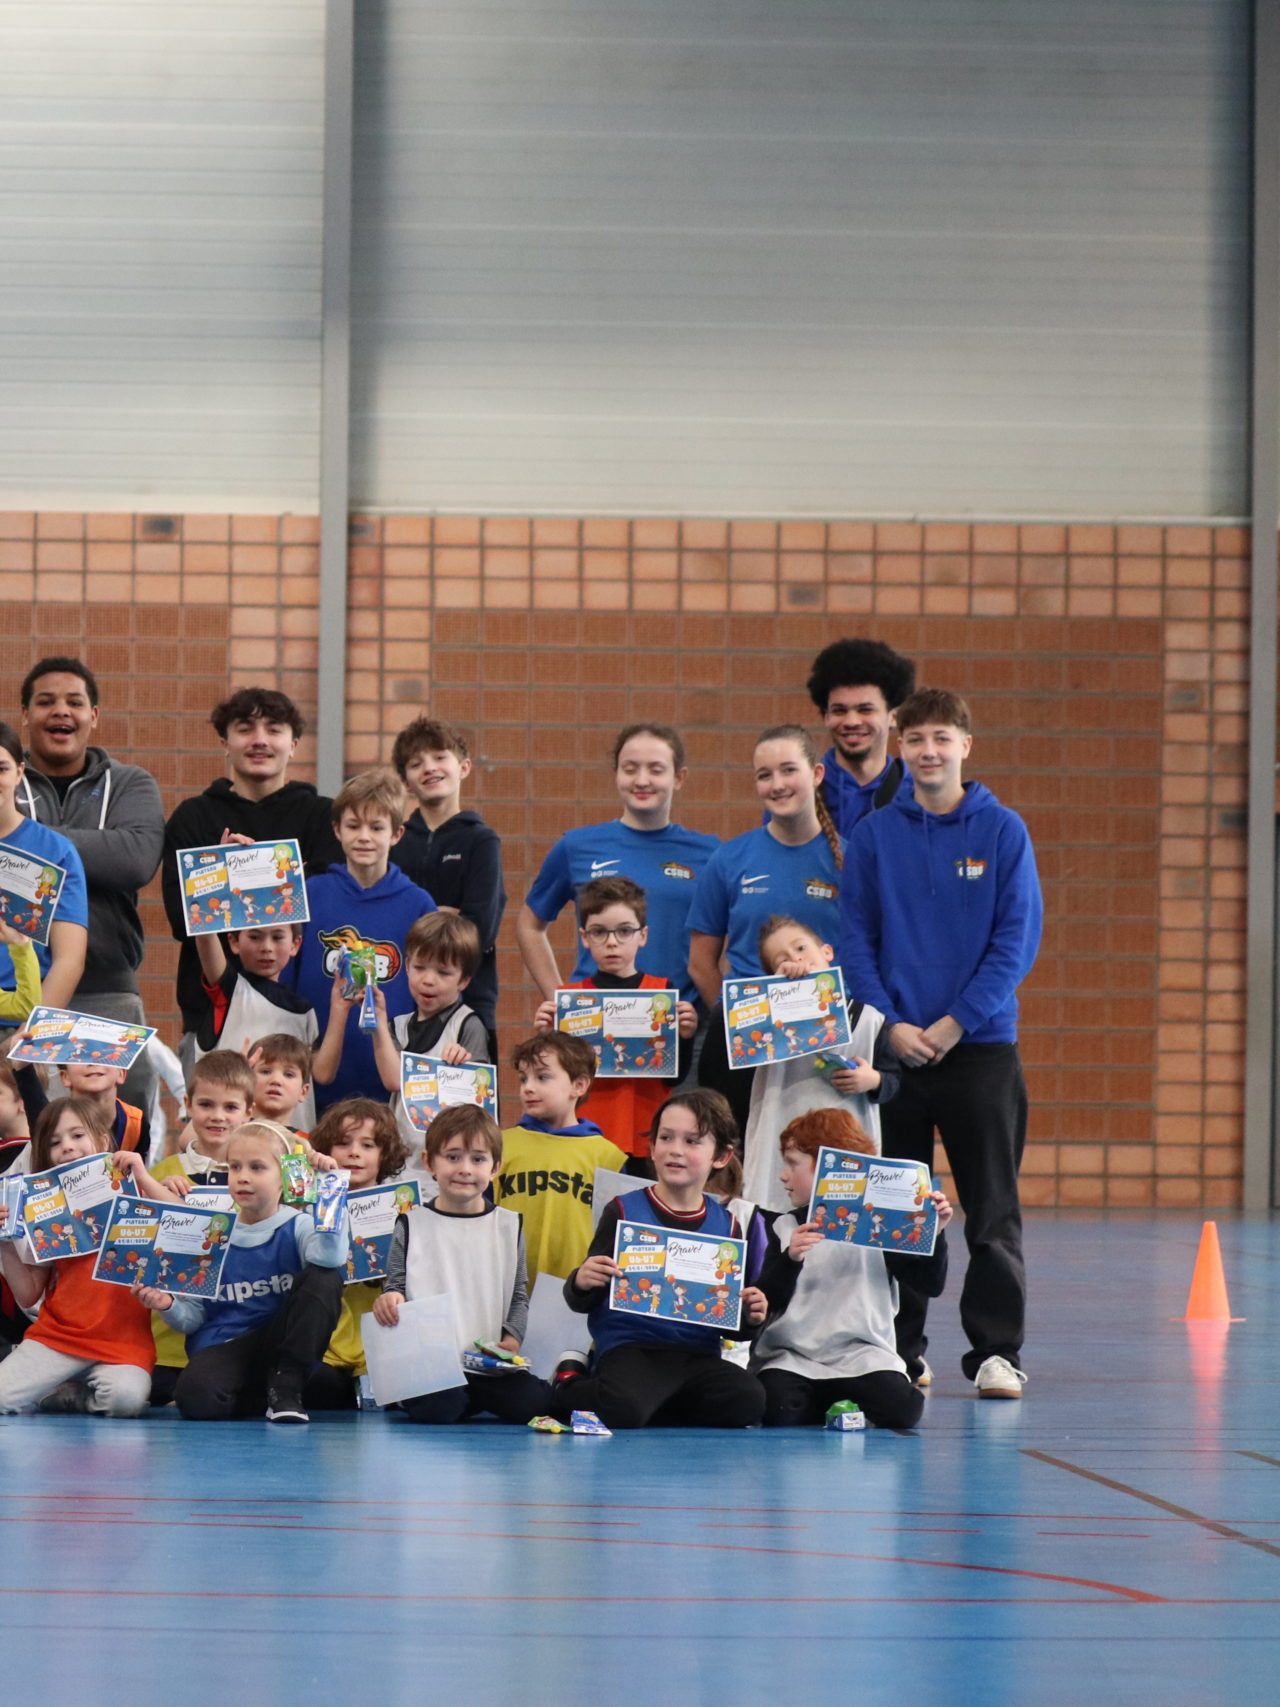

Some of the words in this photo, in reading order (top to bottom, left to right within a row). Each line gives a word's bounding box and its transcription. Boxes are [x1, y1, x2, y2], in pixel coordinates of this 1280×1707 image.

[193, 874, 217, 887] U6-U7
[498, 1170, 593, 1209] kipsta
[828, 1182, 855, 1191] U6-U7
[32, 1200, 55, 1212] U6-U7
[120, 1228, 146, 1237] U6-U7
[628, 1255, 654, 1263] U6-U7
